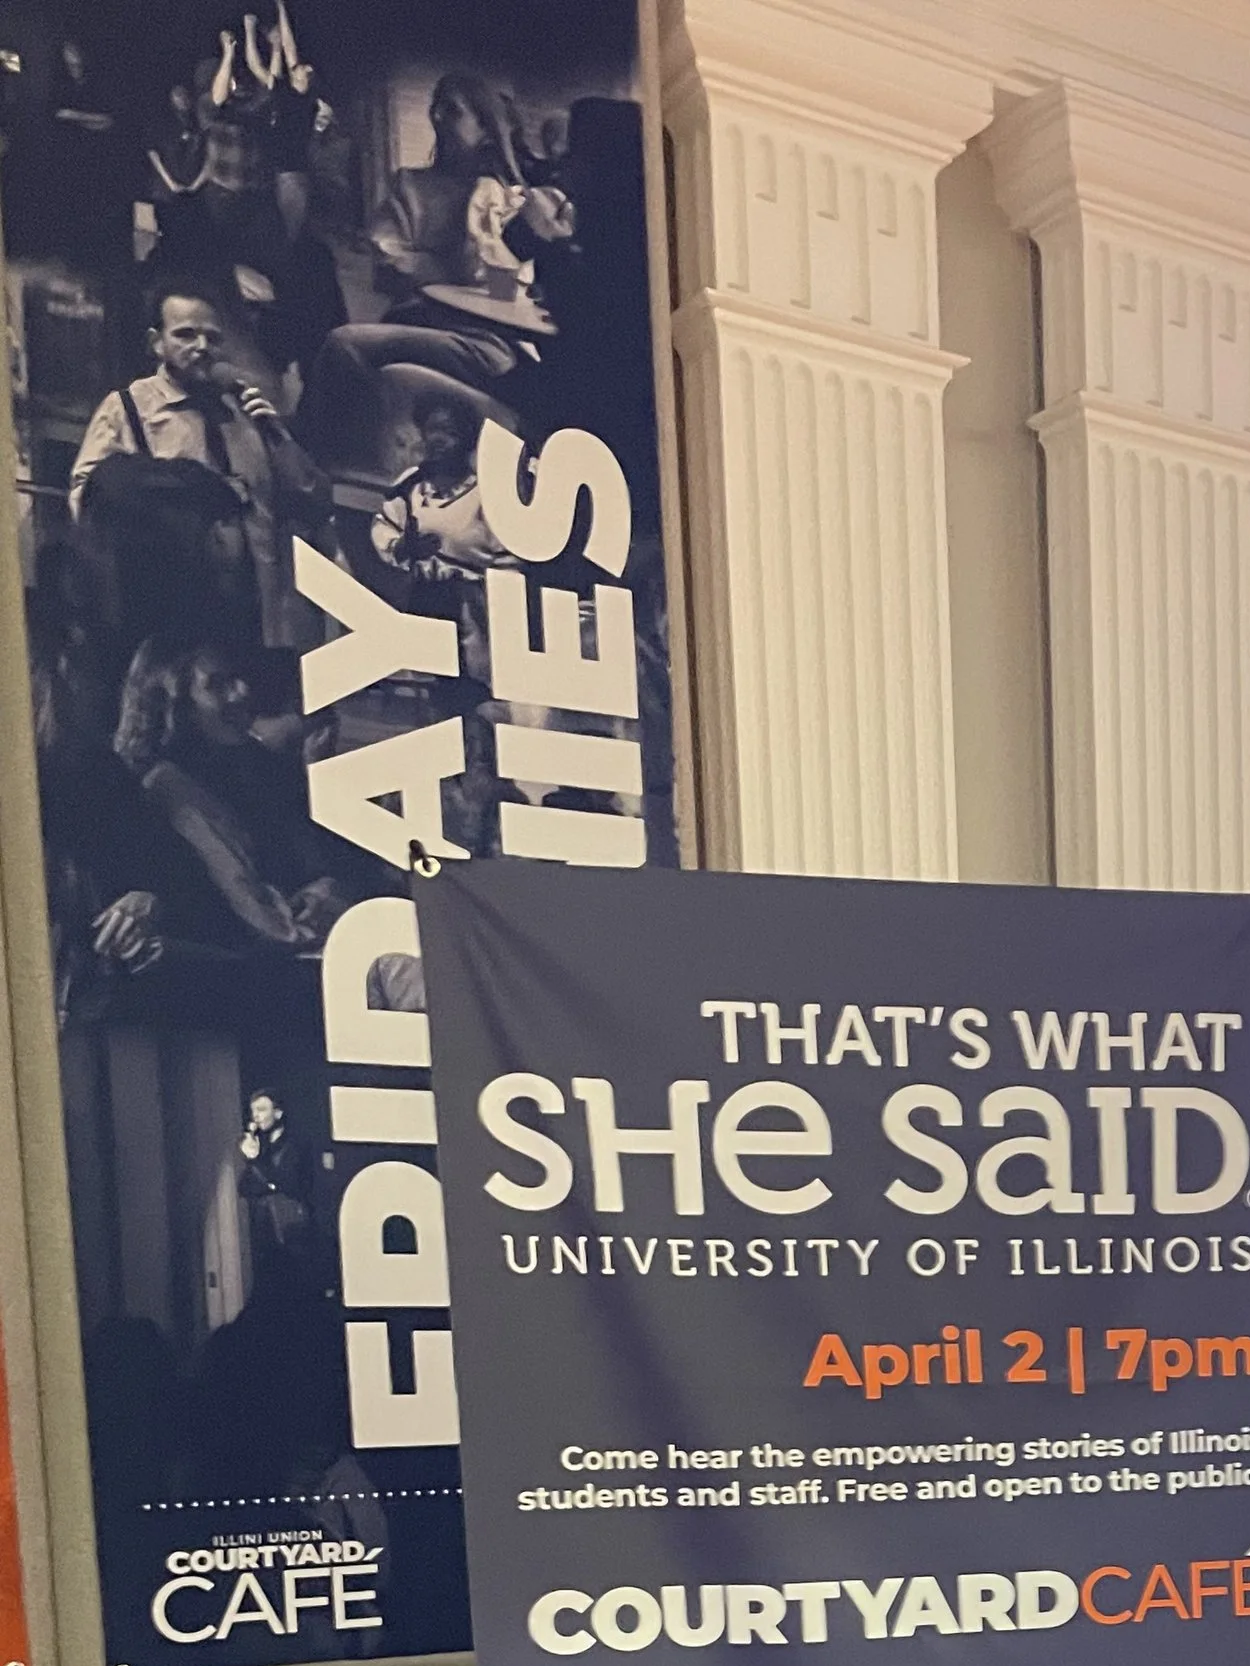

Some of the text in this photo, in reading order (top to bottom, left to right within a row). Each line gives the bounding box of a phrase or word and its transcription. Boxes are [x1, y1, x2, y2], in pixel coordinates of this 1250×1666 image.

[700, 1000, 1242, 1072] THAT'S WHAT
[501, 1234, 879, 1277] UNIVERSITY
[907, 1238, 979, 1277] OF
[803, 1325, 983, 1401] April
[1003, 1329, 1047, 1384] 2
[561, 1446, 659, 1471] Come
[668, 1445, 743, 1469] hear
[750, 1443, 805, 1468] the
[812, 1437, 1016, 1470] empowering
[1022, 1433, 1126, 1460] stories
[1131, 1431, 1164, 1455] of
[518, 1484, 669, 1511] students
[677, 1482, 741, 1507] and
[750, 1479, 830, 1506] staff.
[837, 1476, 908, 1502] Free
[916, 1474, 977, 1500] and
[984, 1476, 1064, 1502] open
[1068, 1472, 1103, 1493] to
[1108, 1468, 1161, 1492] the
[165, 1540, 367, 1575] COURTYARD
[266, 1529, 324, 1544] UNION
